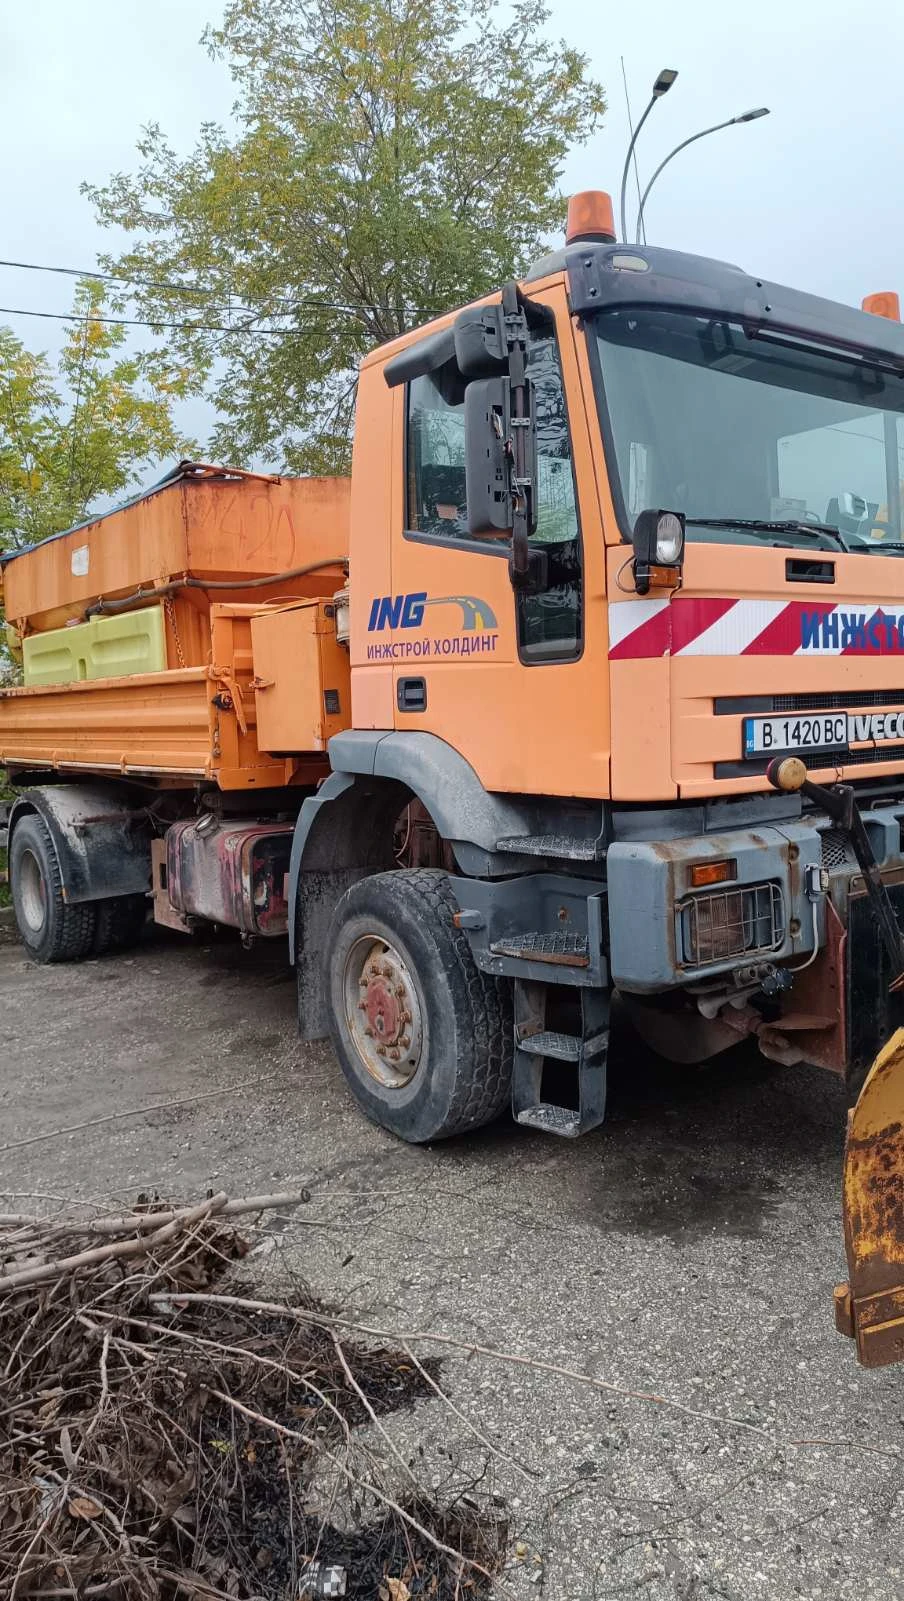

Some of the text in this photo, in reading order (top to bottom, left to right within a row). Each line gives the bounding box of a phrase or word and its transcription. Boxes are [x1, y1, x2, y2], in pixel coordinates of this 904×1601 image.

[368, 592, 427, 632] ING
[367, 635, 499, 659] ИНЖСТРОЙ ХОЛДИНГ
[784, 719, 821, 747] 1420
[824, 718, 844, 743] BC
